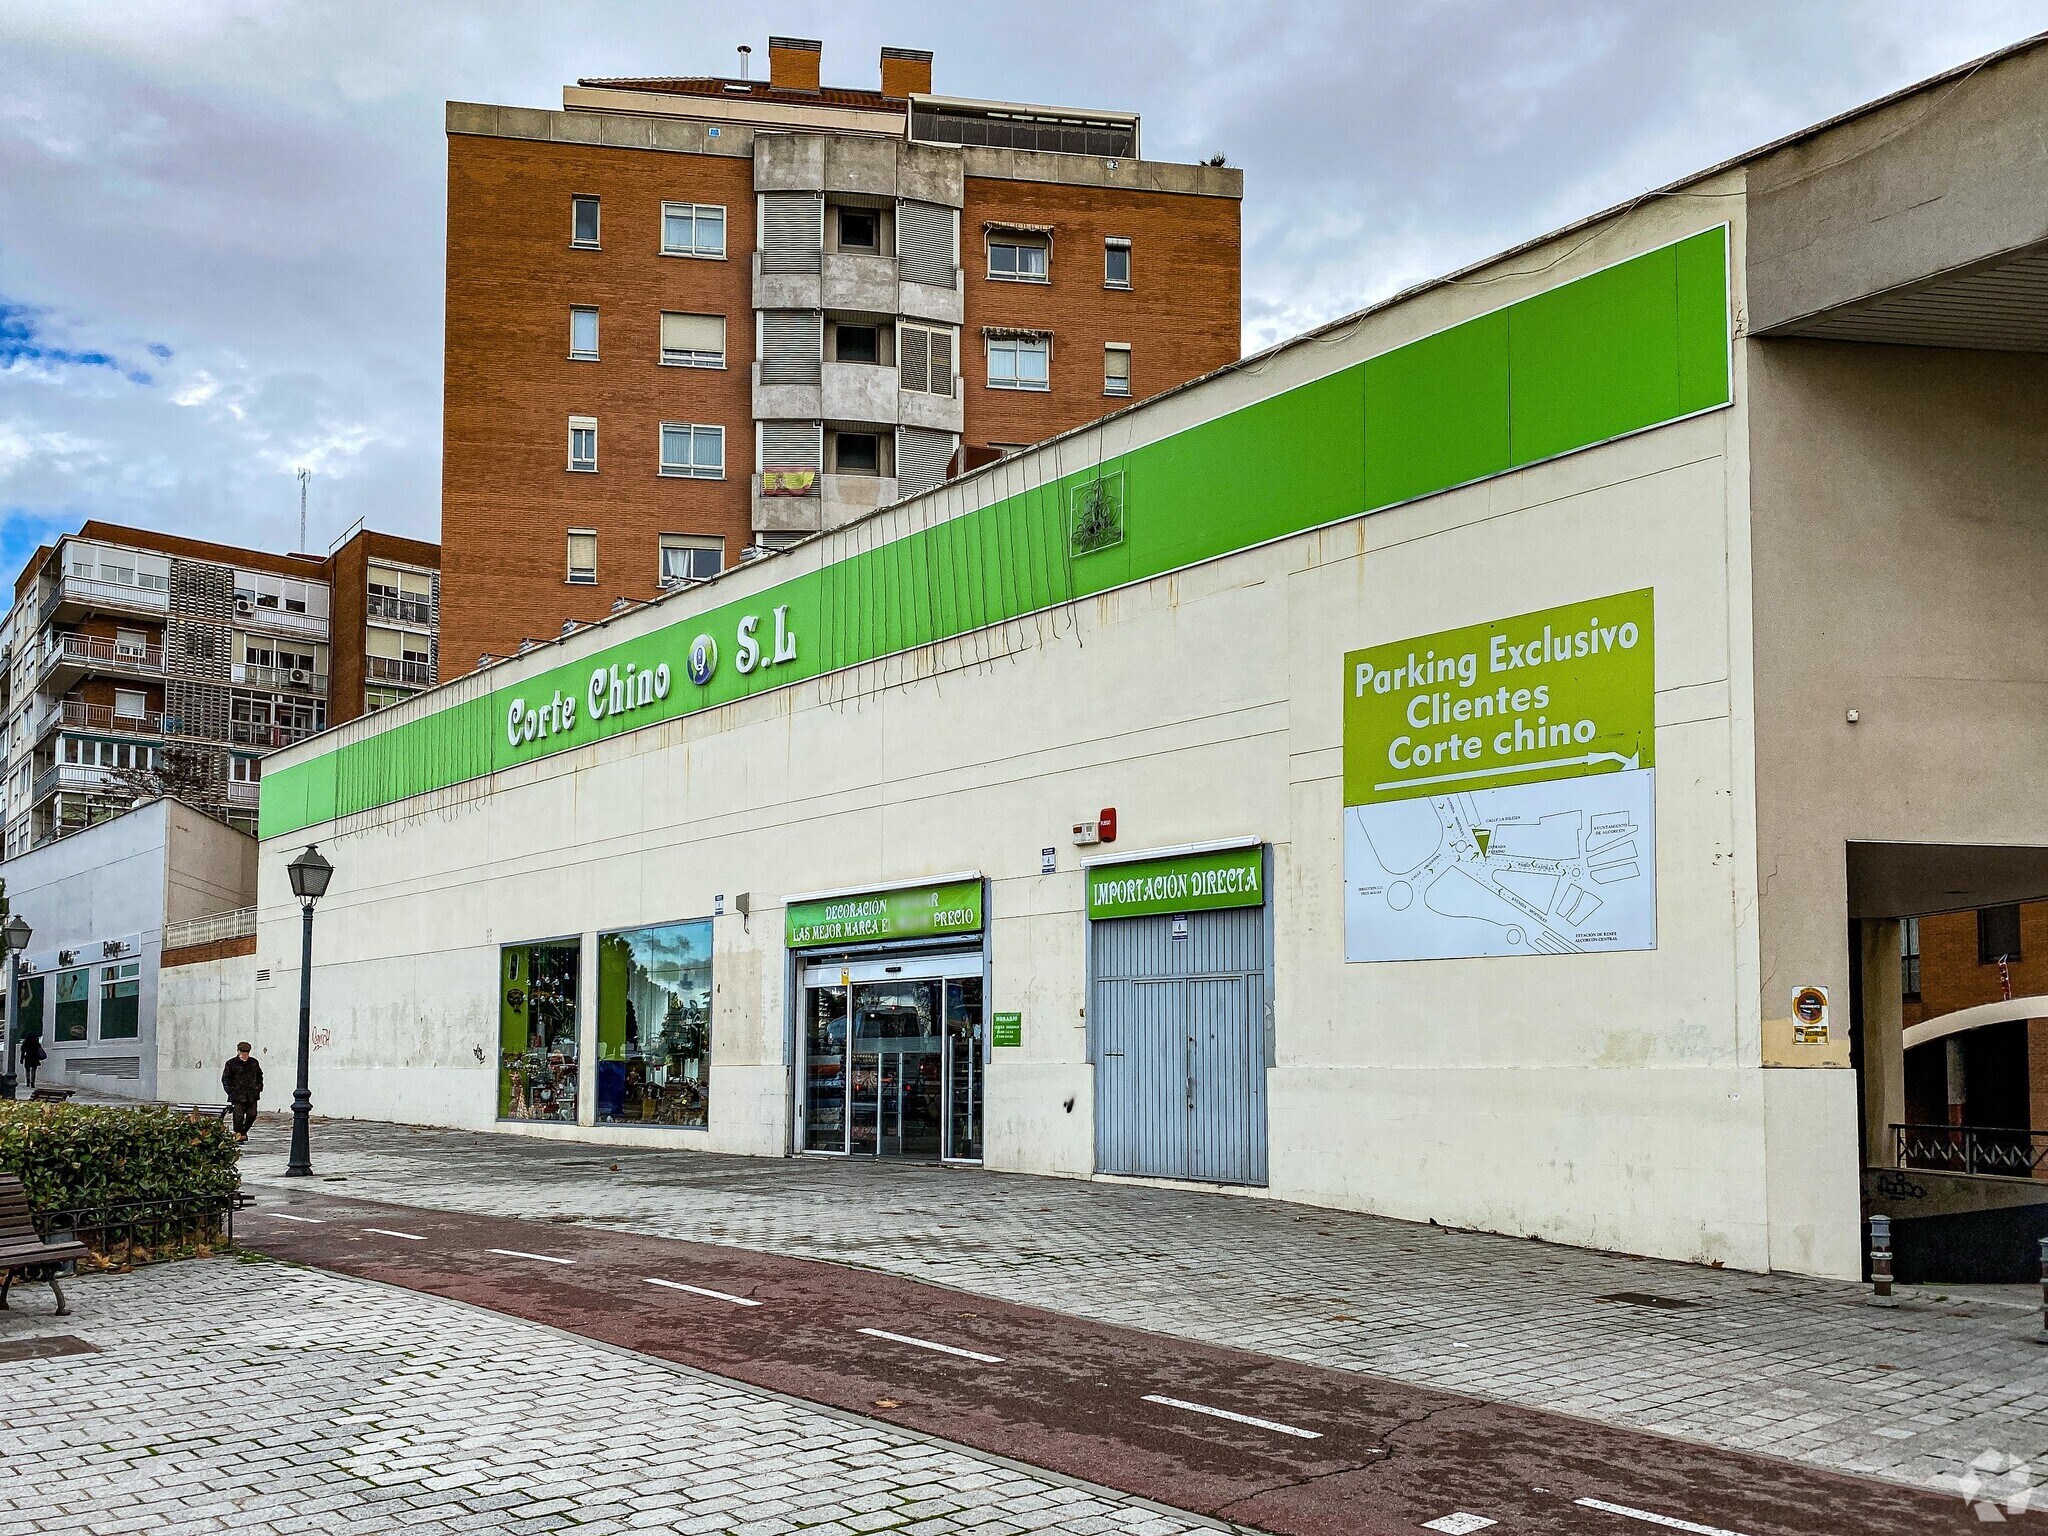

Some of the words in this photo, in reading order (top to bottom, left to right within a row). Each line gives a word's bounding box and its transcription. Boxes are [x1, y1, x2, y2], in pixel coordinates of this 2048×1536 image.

[508, 690, 576, 746] Corte
[588, 663, 671, 720] Chino
[736, 605, 797, 674] S.L
[1355, 650, 1478, 698] Parking
[1490, 617, 1640, 673] Exclusivo
[1406, 684, 1550, 729] Clientes
[1388, 732, 1482, 770] Corte
[1493, 716, 1596, 755] chino
[1093, 869, 1188, 906] IMPORTACIÓN
[1191, 866, 1259, 897] DIRECTA
[793, 927, 811, 942] LAS
[812, 923, 842, 940] MEJOR
[844, 920, 880, 937] MARCA
[933, 908, 974, 927] PRECIO
[825, 897, 887, 921] DECORACIÓN
